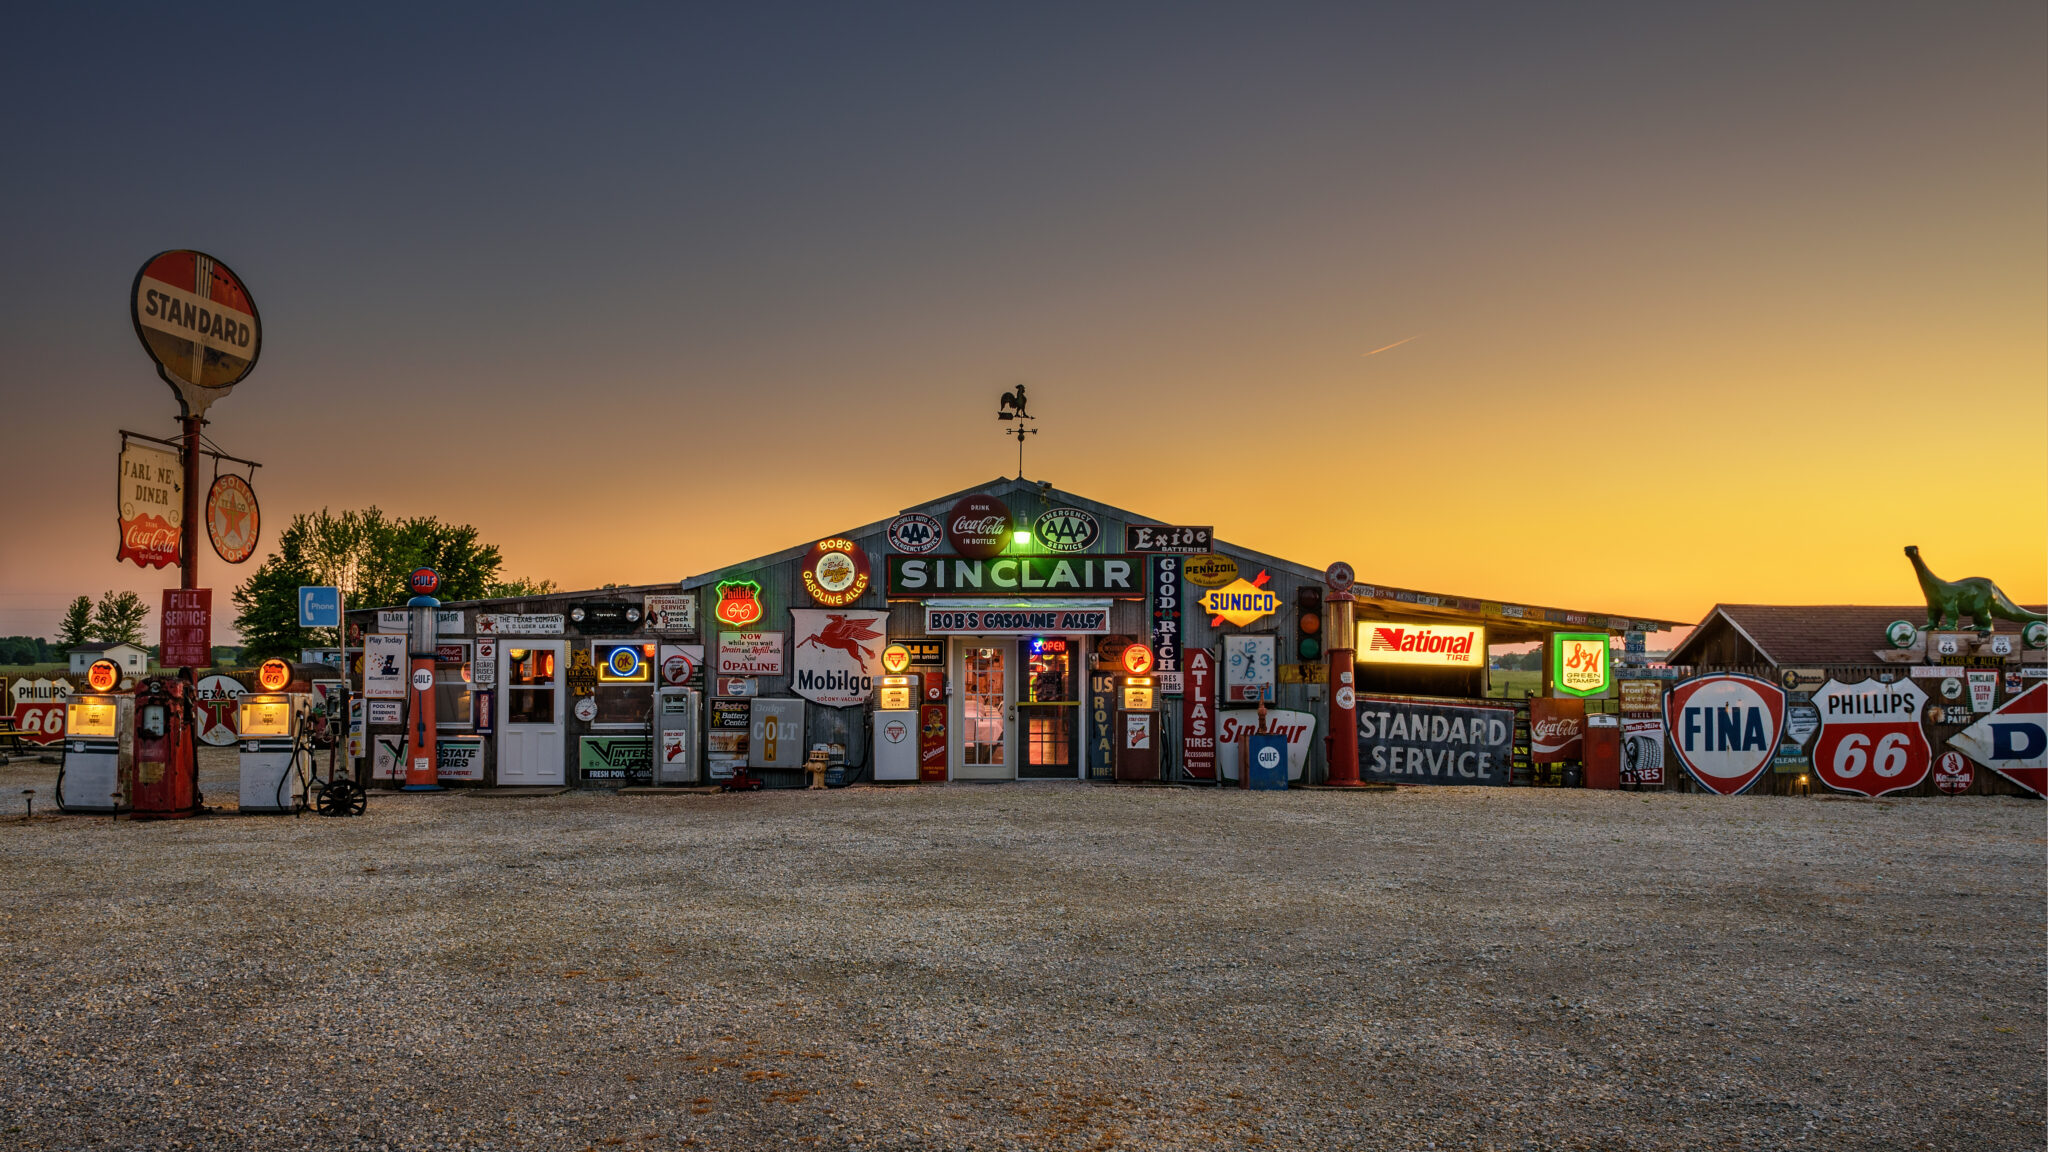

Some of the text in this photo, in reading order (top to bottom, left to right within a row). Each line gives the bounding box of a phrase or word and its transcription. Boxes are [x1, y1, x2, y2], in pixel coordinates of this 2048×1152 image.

[145, 288, 250, 348] STANDARD
[135, 485, 168, 506] DINER
[1040, 509, 1092, 523] EMERGENCY
[915, 515, 928, 523] AUTO
[928, 520, 940, 532] CLUB
[952, 515, 1006, 535] Coca-Cola
[1044, 516, 1089, 543] AAA
[125, 525, 176, 553] Coca-Cola
[900, 523, 931, 544] AAA
[1134, 527, 1208, 550] Exide
[818, 540, 853, 552] BOB'S
[891, 535, 940, 553] EMERGENCY SERVICE
[1046, 540, 1084, 550] SERVICE
[900, 559, 1131, 588] SINCLAIR
[1185, 563, 1237, 575] PENNZOIL
[412, 575, 436, 587] GULF
[802, 570, 843, 604] GASOLINE
[721, 585, 756, 600] Phillips
[845, 573, 869, 604] ALLEY
[170, 593, 201, 609] FULL
[311, 602, 335, 610] Phone
[1209, 592, 1274, 612] SUNOCO
[383, 613, 404, 622] OZARK
[659, 610, 688, 618] Ormond
[726, 602, 752, 620] 66
[165, 611, 207, 626] SERVICE
[662, 615, 689, 625] Beach
[930, 612, 1105, 630] BOB'S GASOLINE ALLEY
[368, 636, 403, 645] Play Today
[1041, 641, 1066, 651] OPEN
[1244, 641, 1257, 653] 12
[1369, 627, 1475, 654] National
[721, 645, 742, 654] Drain
[751, 645, 770, 655] Refill
[1941, 645, 1954, 653] 66
[1995, 645, 2008, 653] 66
[617, 655, 631, 669] OK
[1231, 654, 1242, 666] 9
[1260, 653, 1270, 666] 3
[1446, 653, 1470, 661] TIRE
[1565, 642, 1602, 673] S&H
[1945, 656, 2001, 665] GASOLINE ALLEY
[722, 660, 779, 671] OPALINE
[413, 674, 431, 684] GULF
[1161, 674, 1177, 682] IRES
[1247, 666, 1256, 679] 6
[1969, 674, 1995, 682] SINCLAIR
[94, 676, 107, 685] 66
[265, 674, 280, 685] 66
[798, 669, 872, 696] Mobilga
[18, 686, 67, 699] PHILLIPS
[1190, 653, 1209, 736] ATLAS
[713, 701, 749, 710] Electro
[754, 703, 786, 713] Dodge
[1828, 692, 1916, 714] PHILLIPS
[207, 701, 230, 725] T
[721, 712, 749, 722] Battery
[1947, 715, 1971, 723] PAINT
[21, 708, 65, 735] 66
[723, 719, 749, 727] Center
[1359, 710, 1507, 746] STANDARD
[1535, 717, 1580, 736] Coca-Cola
[1624, 722, 1660, 731] Multi-Mile
[753, 721, 799, 741] COLT
[1093, 696, 1112, 765] ROYAL
[1684, 706, 1768, 752] FINA
[1184, 737, 1214, 748] TIRES
[613, 748, 653, 758] INTERS
[1258, 752, 1278, 762] GULF
[1832, 732, 1911, 778] 66
[1369, 744, 1492, 779] SERVICE
[589, 770, 610, 778] FRESH
